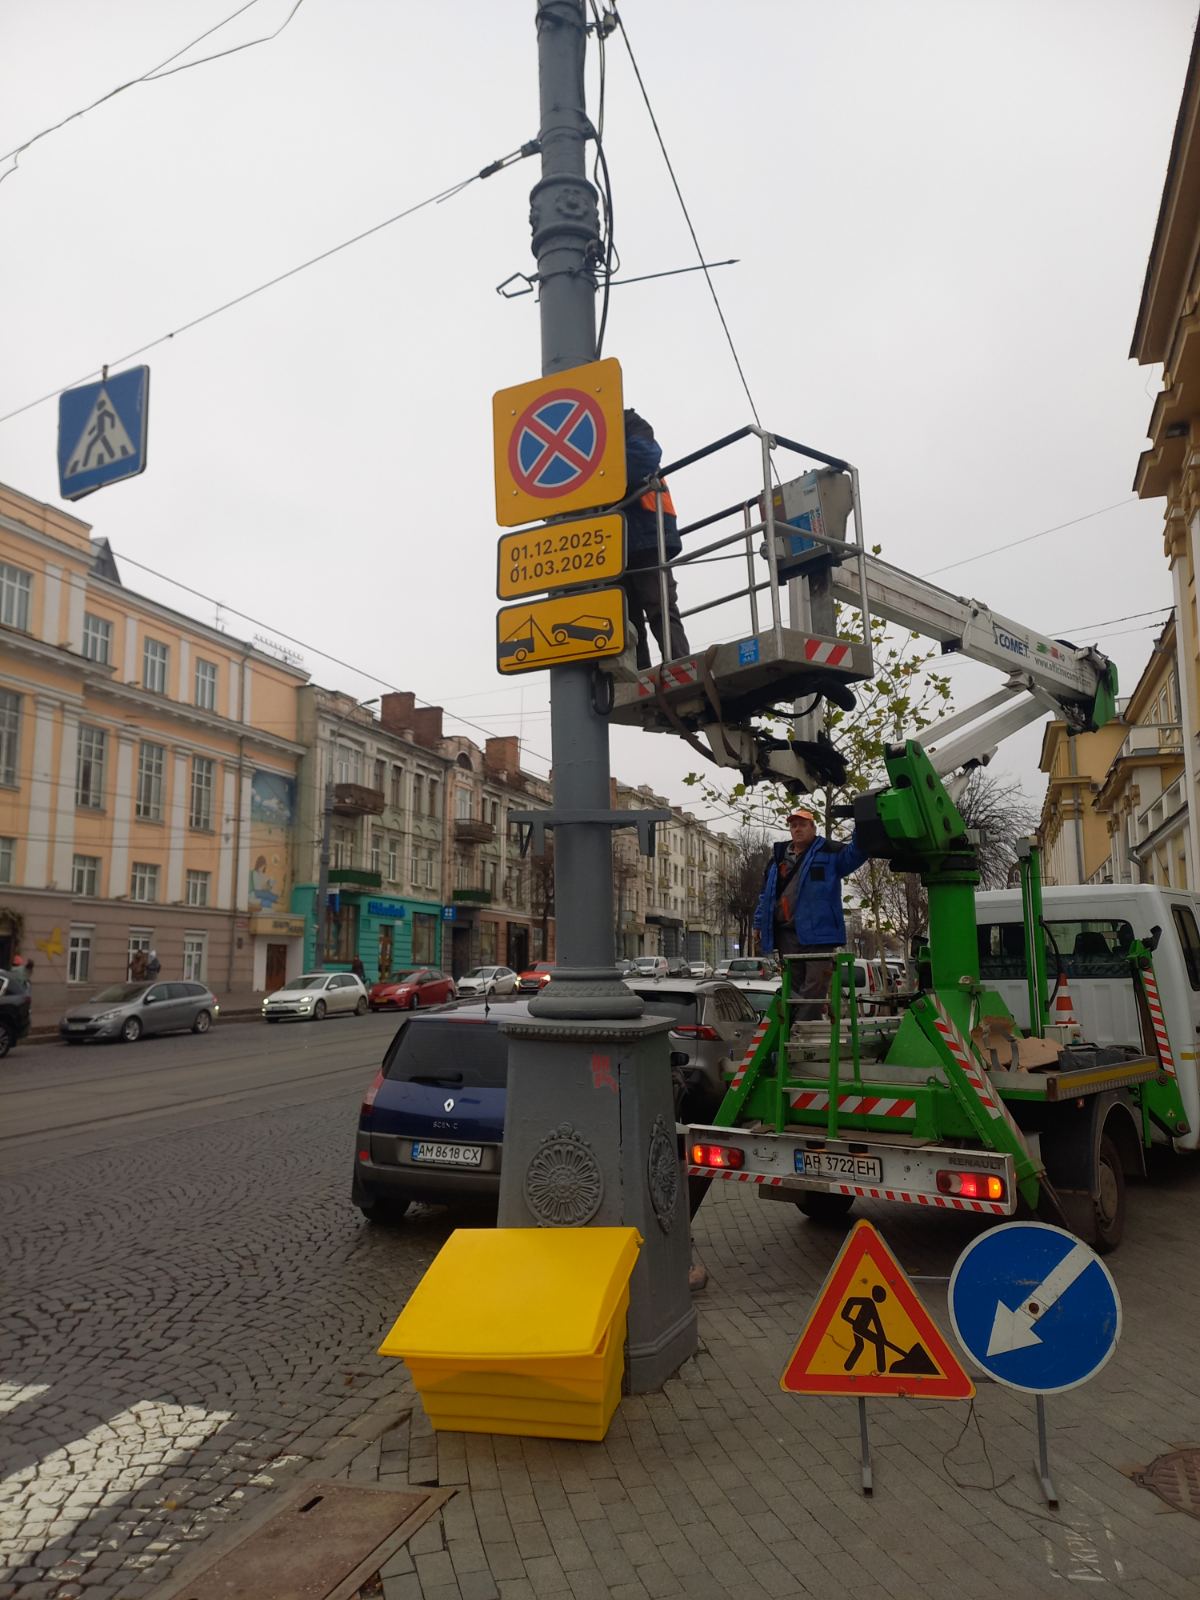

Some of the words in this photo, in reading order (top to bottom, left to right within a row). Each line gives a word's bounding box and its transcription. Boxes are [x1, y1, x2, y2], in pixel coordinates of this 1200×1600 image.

[511, 529, 612, 562] 01.12.2025-
[510, 548, 606, 583] 01.03.2026
[999, 634, 1030, 658] COMET
[418, 1145, 434, 1158] AM
[435, 1146, 460, 1160] 8618
[463, 1148, 480, 1161] CX
[825, 1157, 854, 1173] 3722
[857, 1161, 876, 1176] EH
